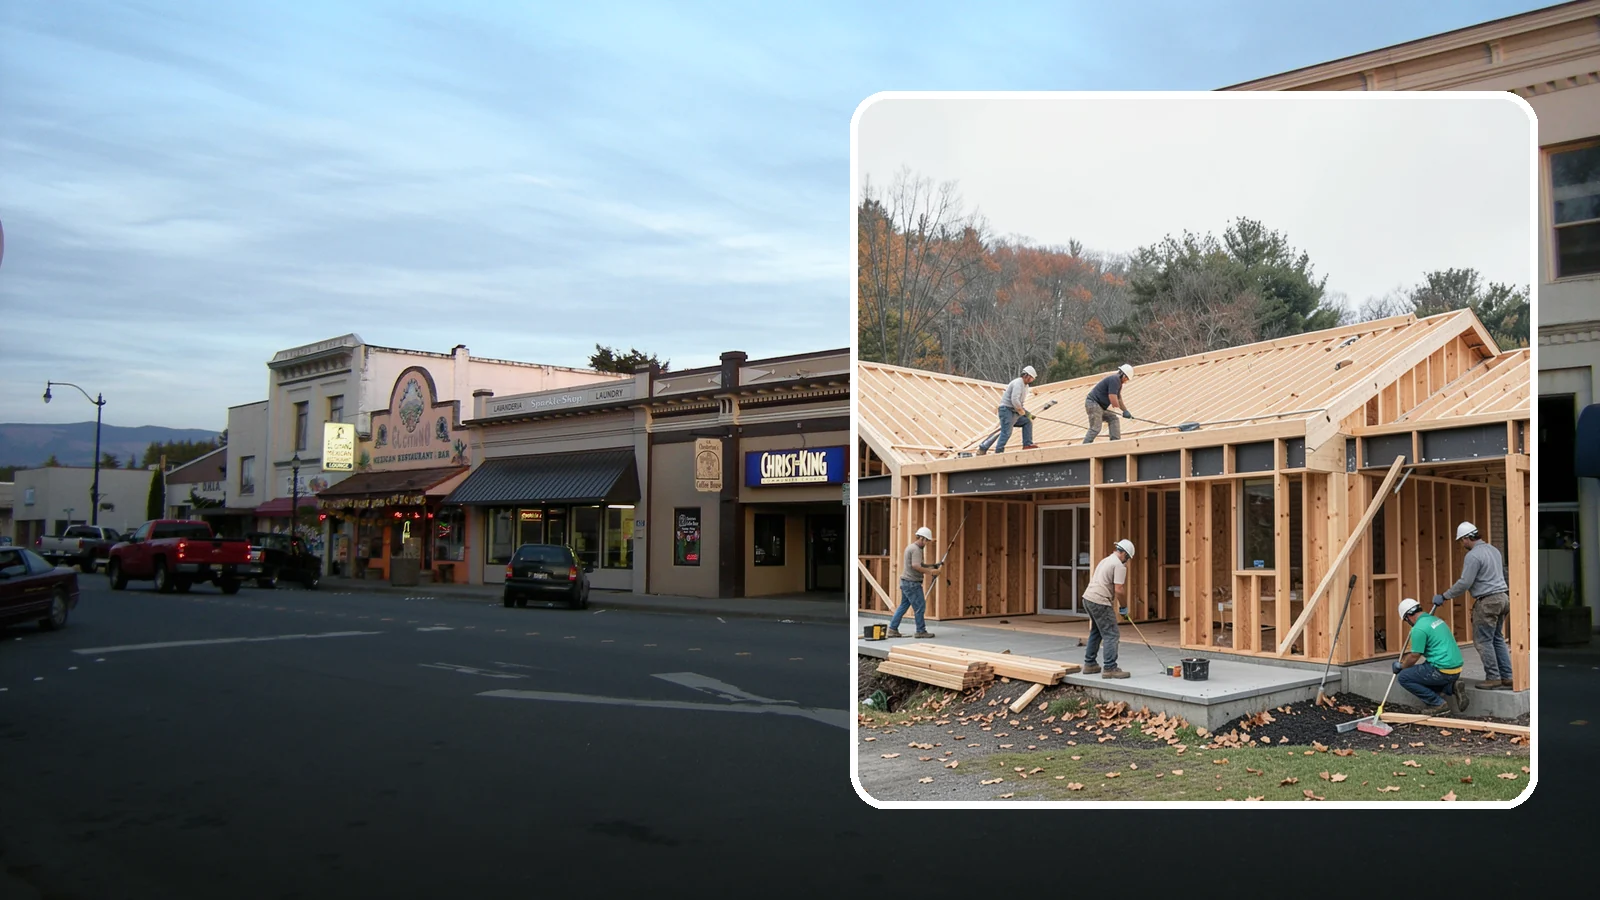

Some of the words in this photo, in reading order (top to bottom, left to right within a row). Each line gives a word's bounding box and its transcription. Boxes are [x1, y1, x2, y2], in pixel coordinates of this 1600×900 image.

[530, 398, 561, 408] Sparkle
[561, 394, 582, 404] Shop
[596, 389, 624, 400] LAUNDRY
[493, 402, 523, 413] LAVANDERIA
[392, 425, 402, 449] EL
[373, 455, 396, 464] MEXICAN
[397, 451, 434, 462] RESTAURANT
[438, 450, 450, 459] BAR
[761, 452, 798, 478] CHRIST
[799, 450, 827, 477] KING
[696, 480, 709, 489] Coffee
[710, 480, 722, 489] House
